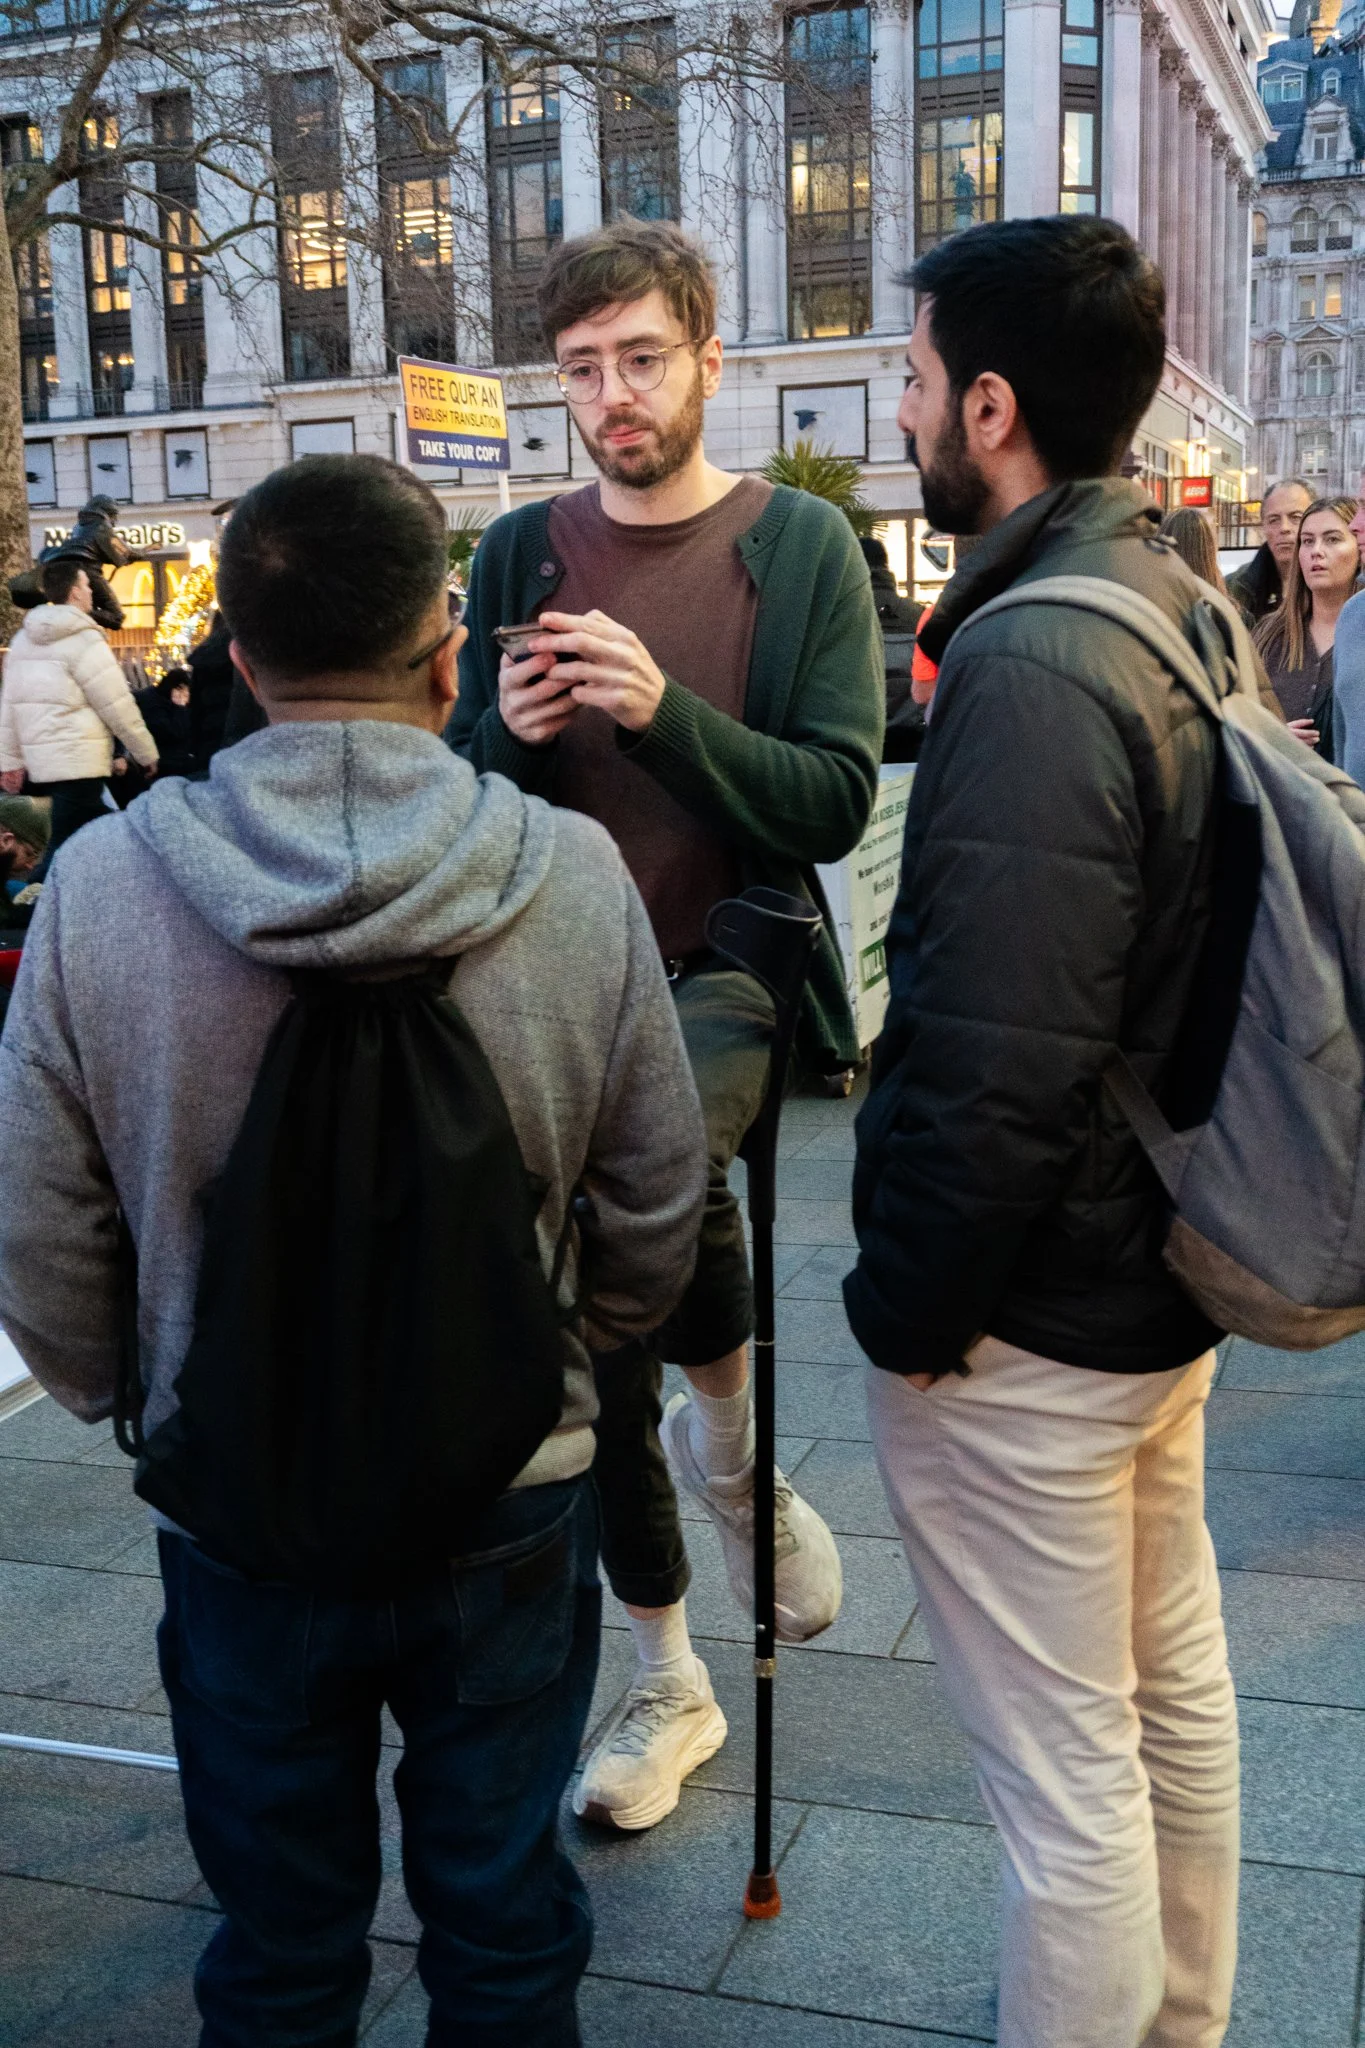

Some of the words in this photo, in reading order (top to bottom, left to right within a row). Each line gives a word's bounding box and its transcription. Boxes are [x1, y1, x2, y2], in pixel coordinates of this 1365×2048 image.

[410, 374, 446, 401] FREE
[449, 380, 498, 408] QUR'AN
[413, 406, 448, 423] ENGLISH
[449, 410, 501, 429] TRANSLATION
[418, 440, 446, 458] TAKE
[447, 442, 475, 461] YOUR
[475, 445, 501, 463] COPY
